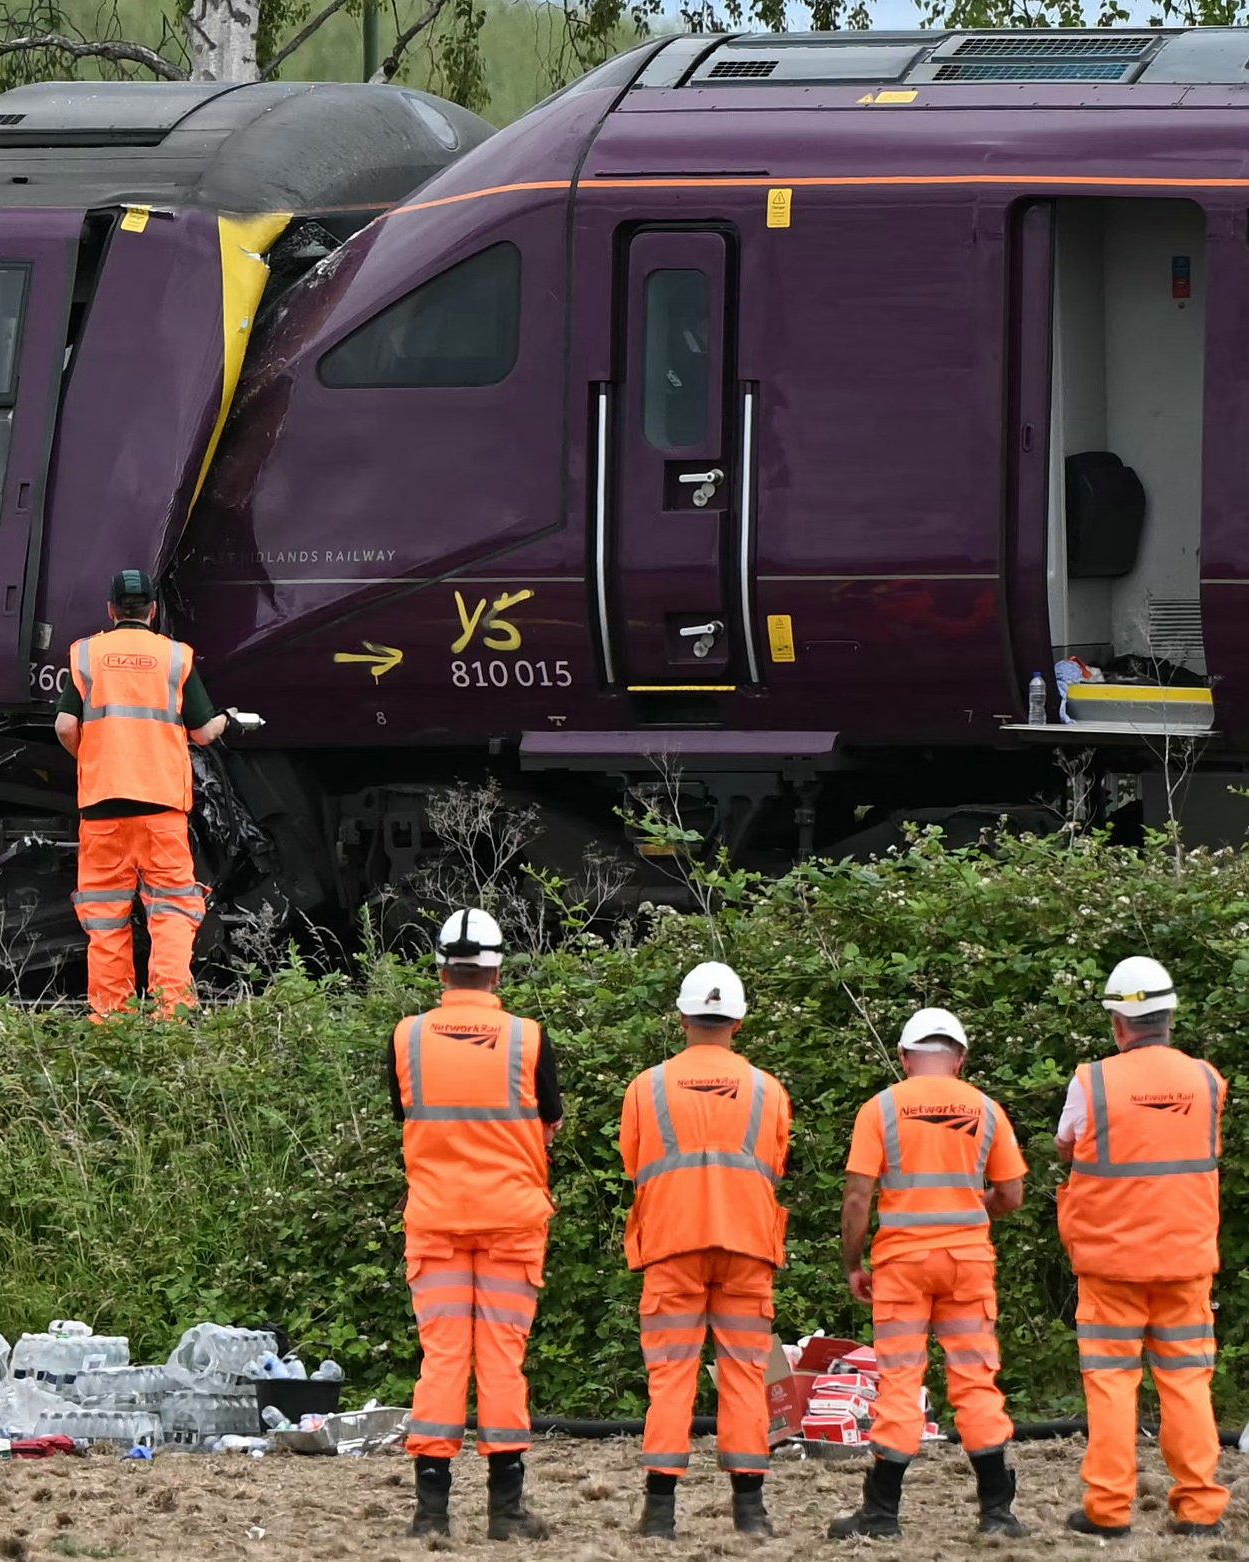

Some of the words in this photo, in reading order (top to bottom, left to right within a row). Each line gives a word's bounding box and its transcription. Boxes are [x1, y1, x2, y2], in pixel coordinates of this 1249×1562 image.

[325, 550, 396, 562] RAILWAY
[451, 660, 509, 688] 810
[514, 660, 572, 687] 015
